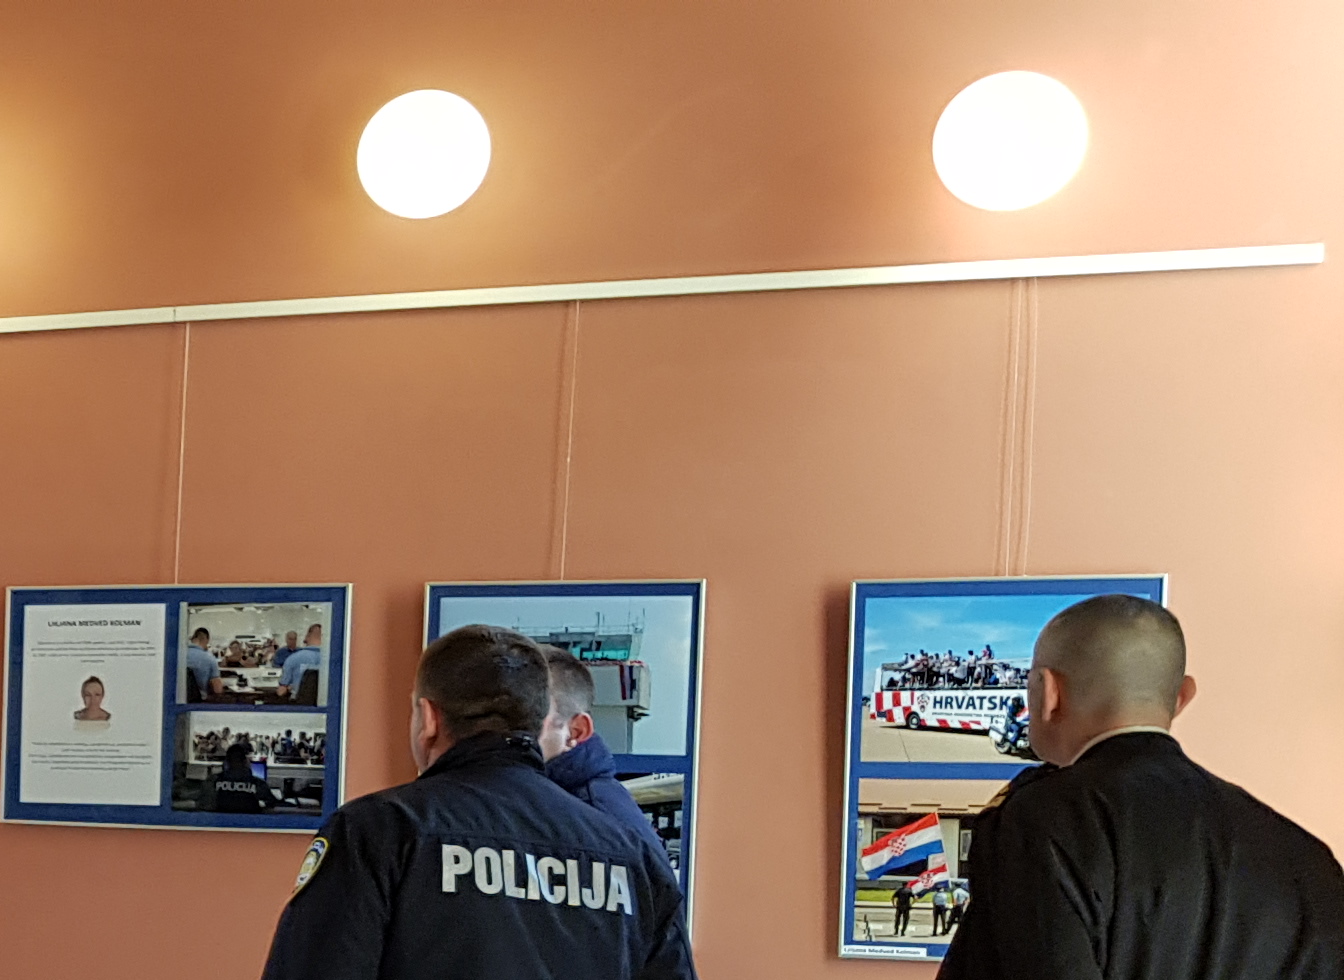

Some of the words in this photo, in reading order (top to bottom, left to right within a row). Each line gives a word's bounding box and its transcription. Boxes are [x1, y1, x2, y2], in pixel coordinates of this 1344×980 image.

[932, 695, 1011, 711] HRVATSK
[215, 780, 257, 794] POLICIJA
[441, 843, 633, 916] POLICIJA
